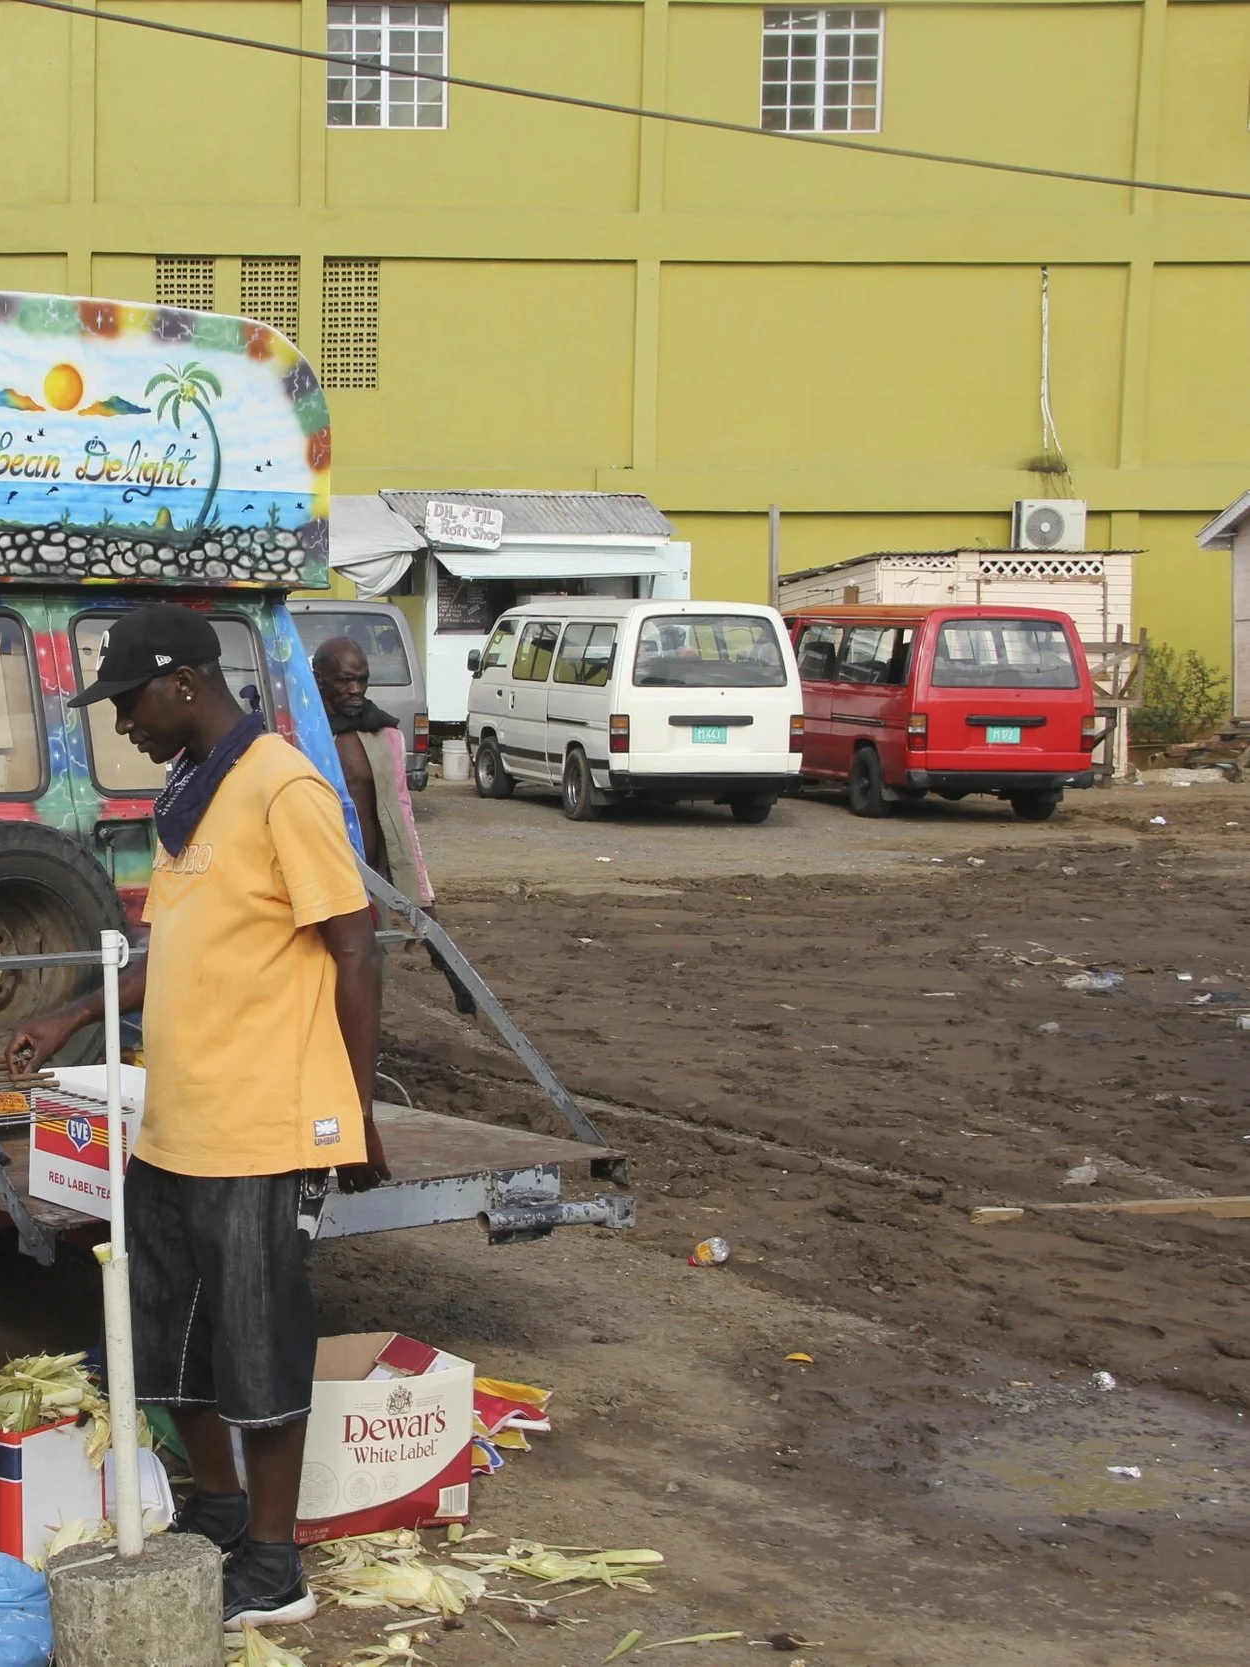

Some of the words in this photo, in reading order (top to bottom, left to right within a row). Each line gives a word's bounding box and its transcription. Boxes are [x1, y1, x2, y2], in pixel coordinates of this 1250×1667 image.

[70, 1119, 89, 1141] EVE
[314, 1134, 341, 1147] UMBRO
[48, 1170, 65, 1185] RED
[67, 1177, 94, 1195] LABEL
[341, 1405, 447, 1444] Dewar's
